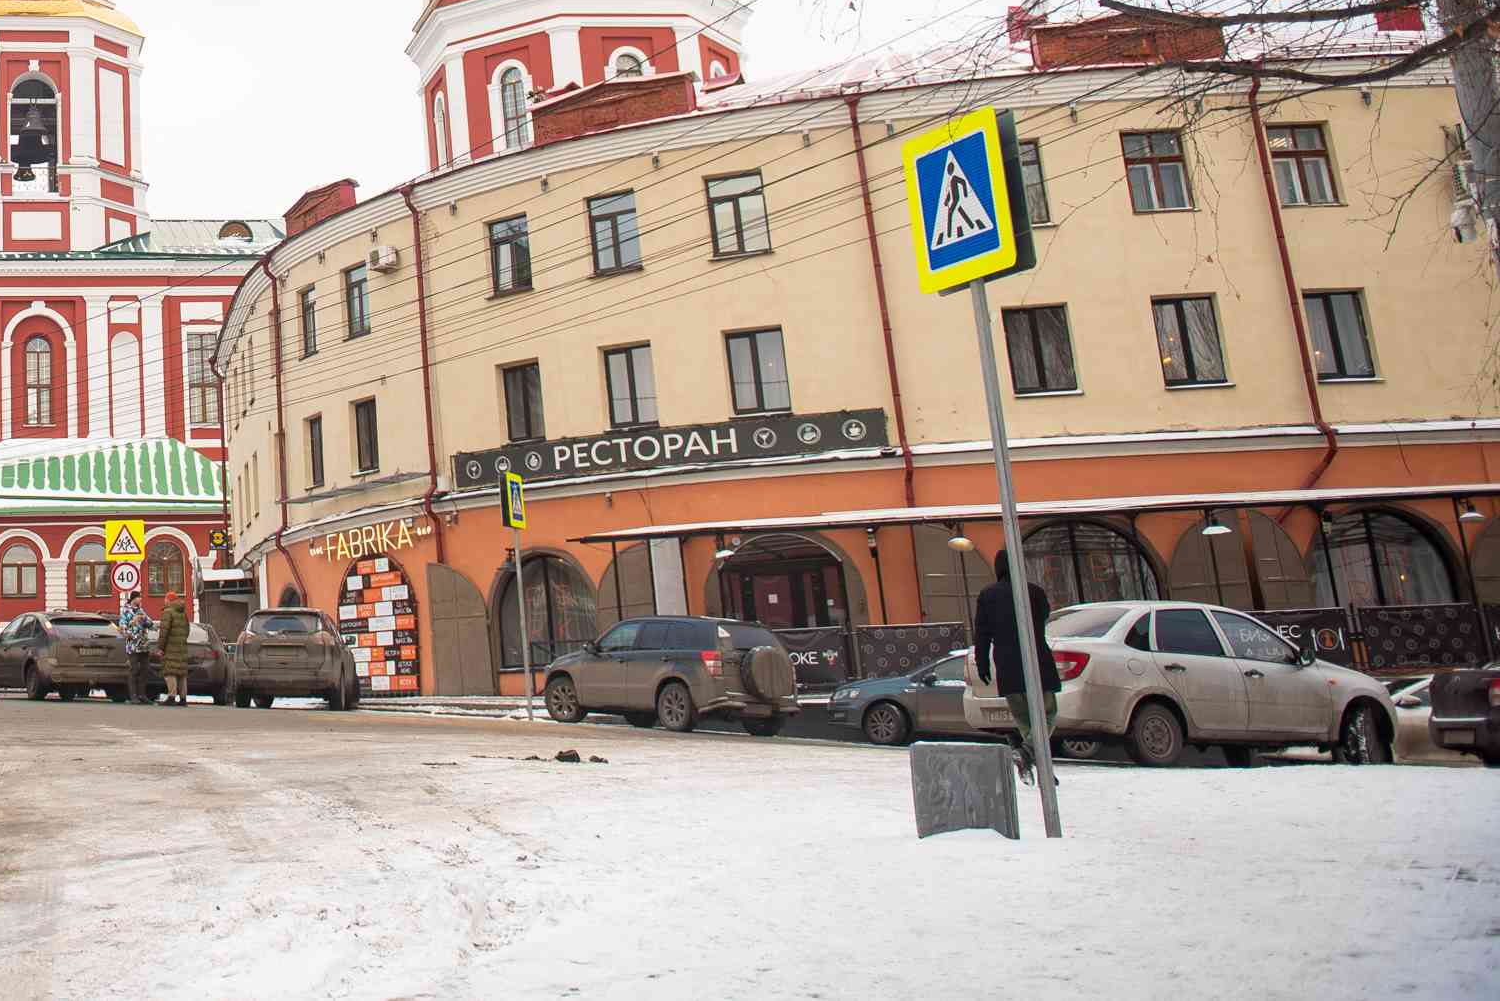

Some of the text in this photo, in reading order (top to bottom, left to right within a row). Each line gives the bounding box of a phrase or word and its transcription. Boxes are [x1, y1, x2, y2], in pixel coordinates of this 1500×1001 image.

[553, 428, 739, 470] РЕСТОРАН
[326, 518, 414, 562] FABRIKA
[117, 571, 134, 582] 40
[788, 651, 819, 665] ОКЕ
